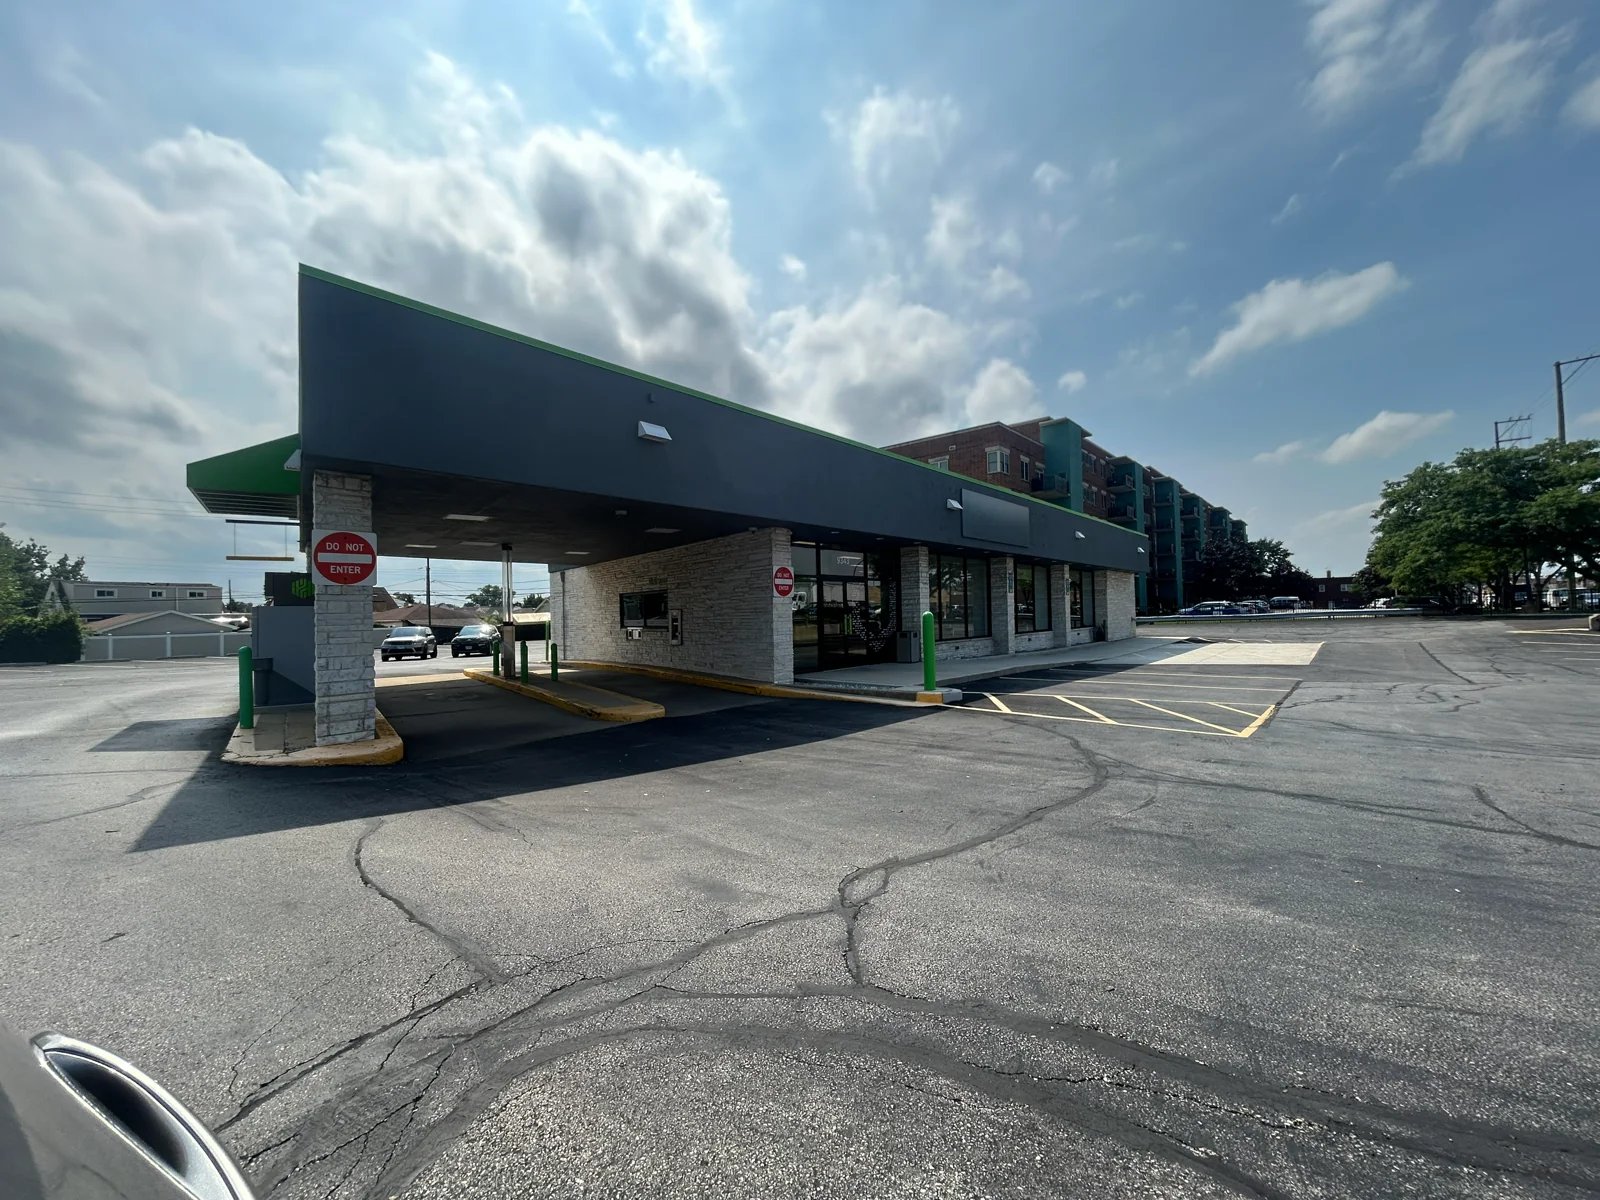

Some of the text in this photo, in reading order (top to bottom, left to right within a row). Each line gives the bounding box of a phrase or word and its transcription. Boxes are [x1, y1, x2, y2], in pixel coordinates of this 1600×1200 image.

[326, 542, 364, 551] DO NOT
[330, 565, 361, 574] ENTER
